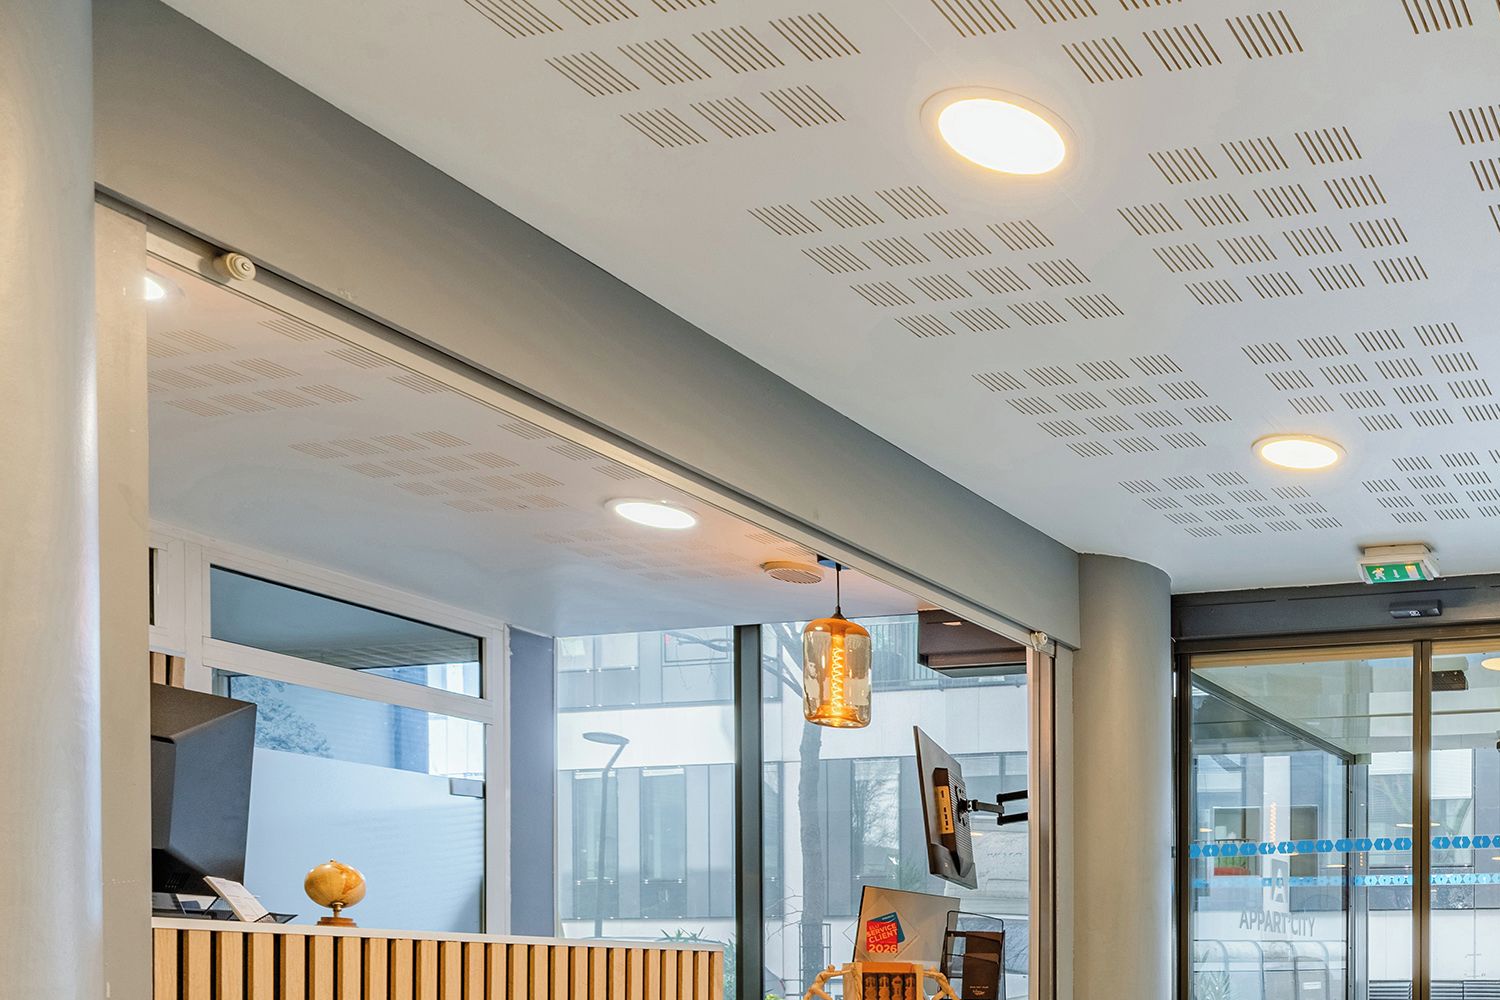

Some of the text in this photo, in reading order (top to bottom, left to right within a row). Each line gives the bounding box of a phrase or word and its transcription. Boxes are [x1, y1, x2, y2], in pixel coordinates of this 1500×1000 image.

[866, 923, 897, 937] SERVICE
[1239, 910, 1315, 937] APPART'CITY
[868, 929, 898, 943] CLIENT
[868, 944, 897, 953] 2026
